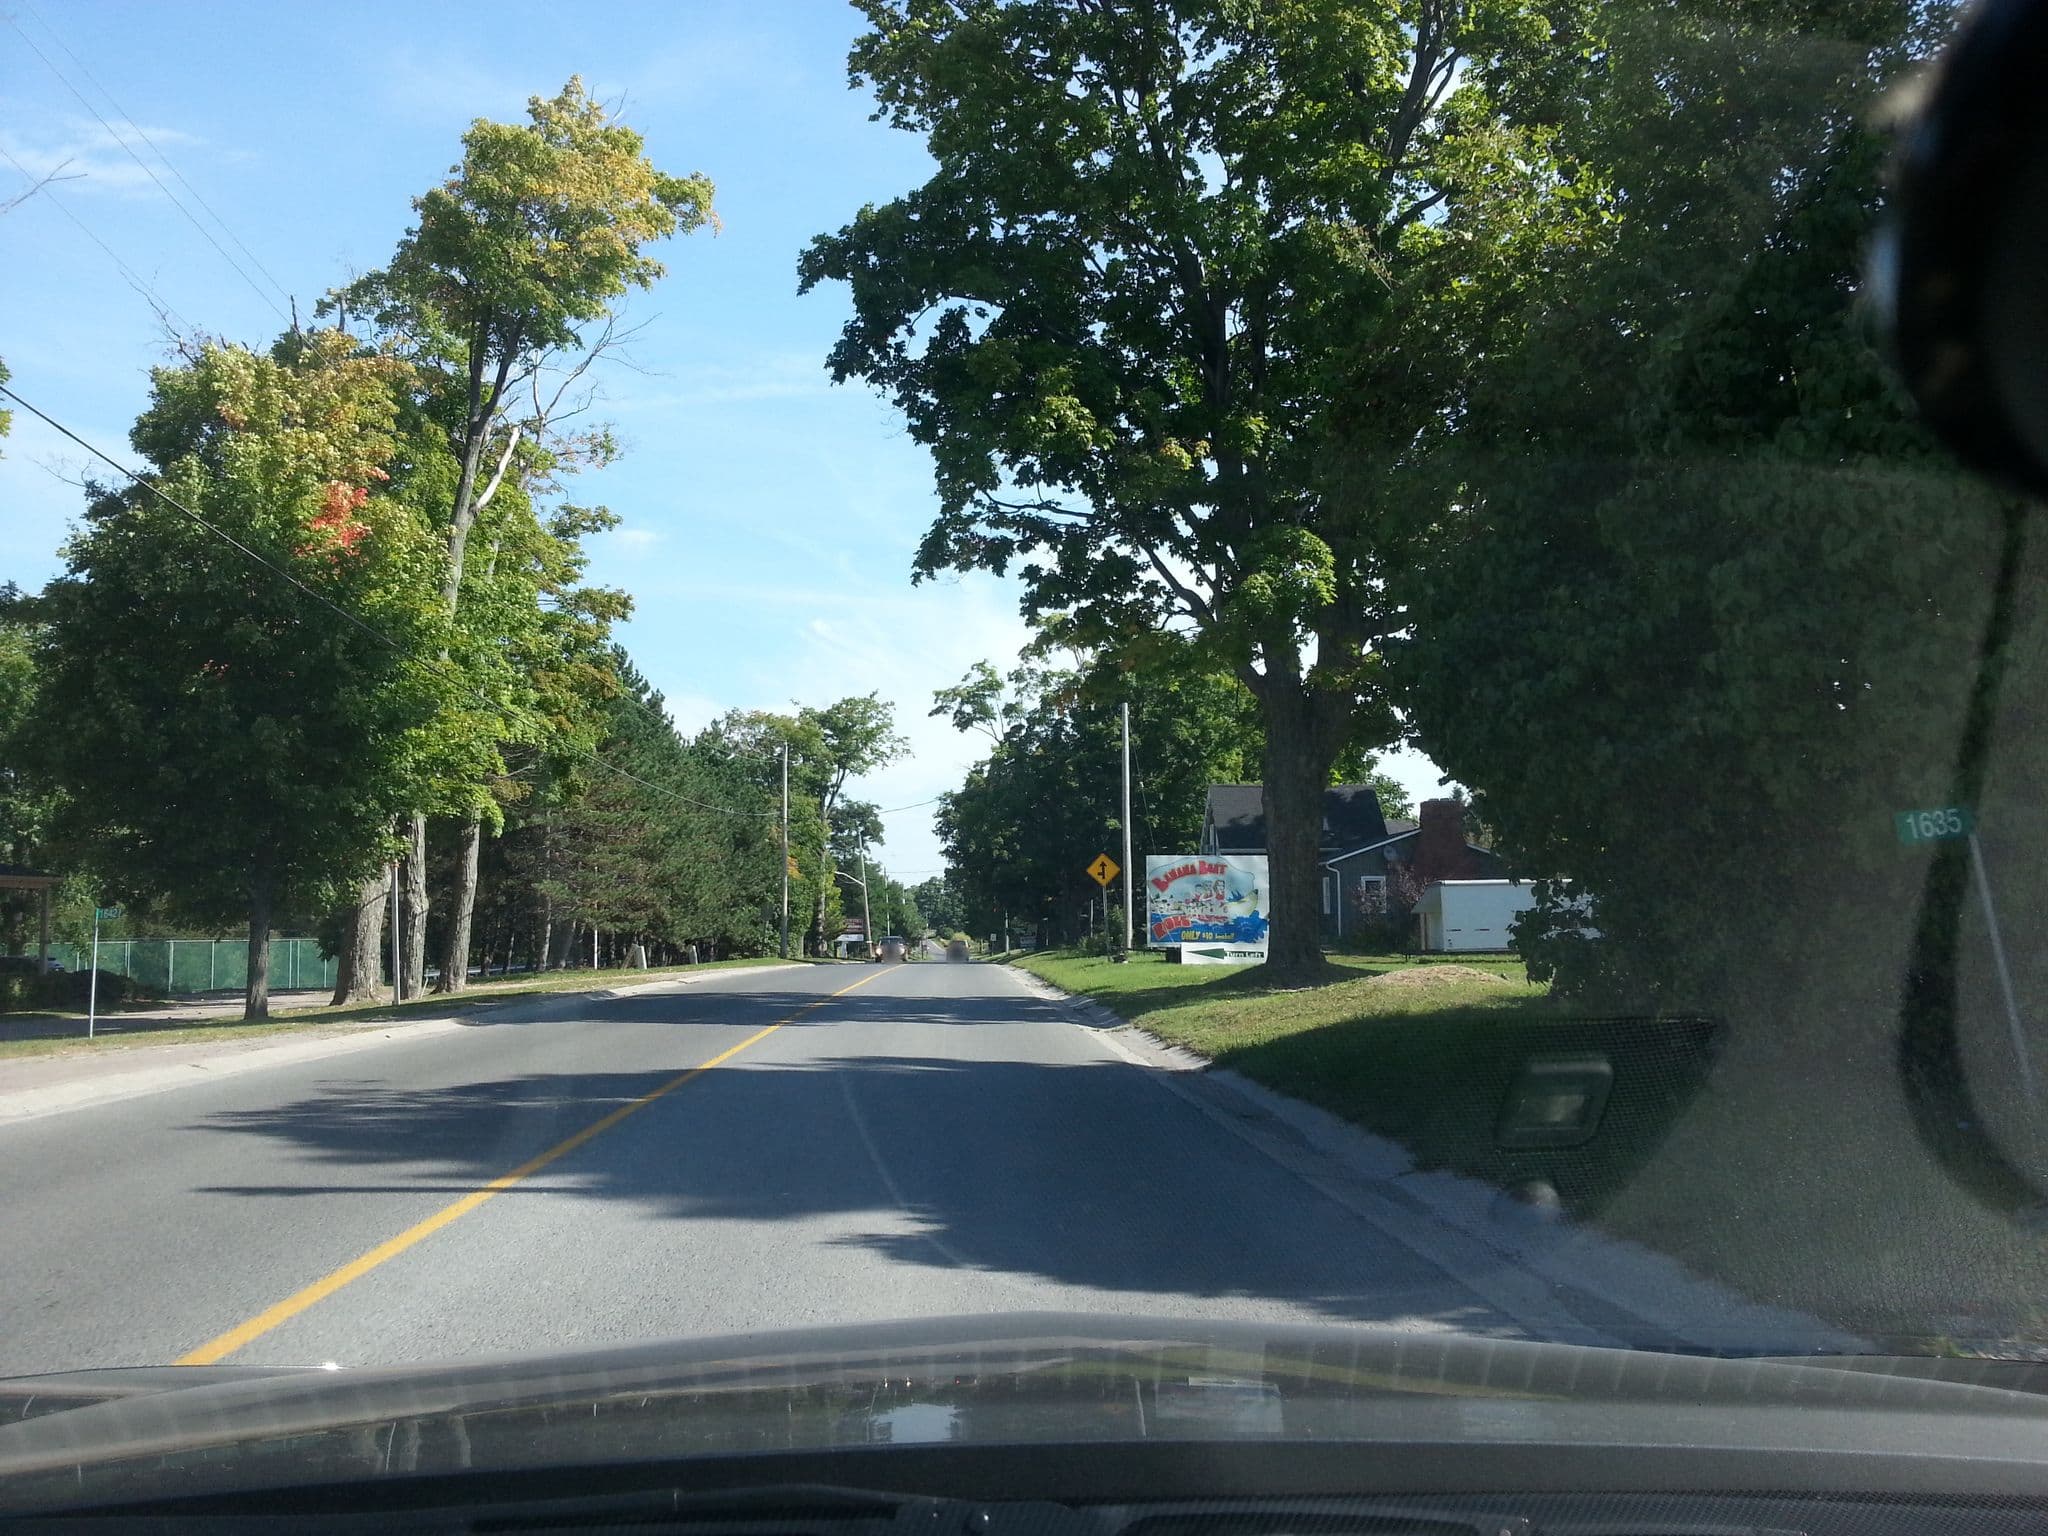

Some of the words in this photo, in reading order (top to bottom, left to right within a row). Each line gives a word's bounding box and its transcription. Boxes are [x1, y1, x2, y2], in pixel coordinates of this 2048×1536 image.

[1906, 808, 1962, 838] 1635
[1151, 863, 1197, 892] BANANA
[1181, 930, 1201, 941] ONLY
